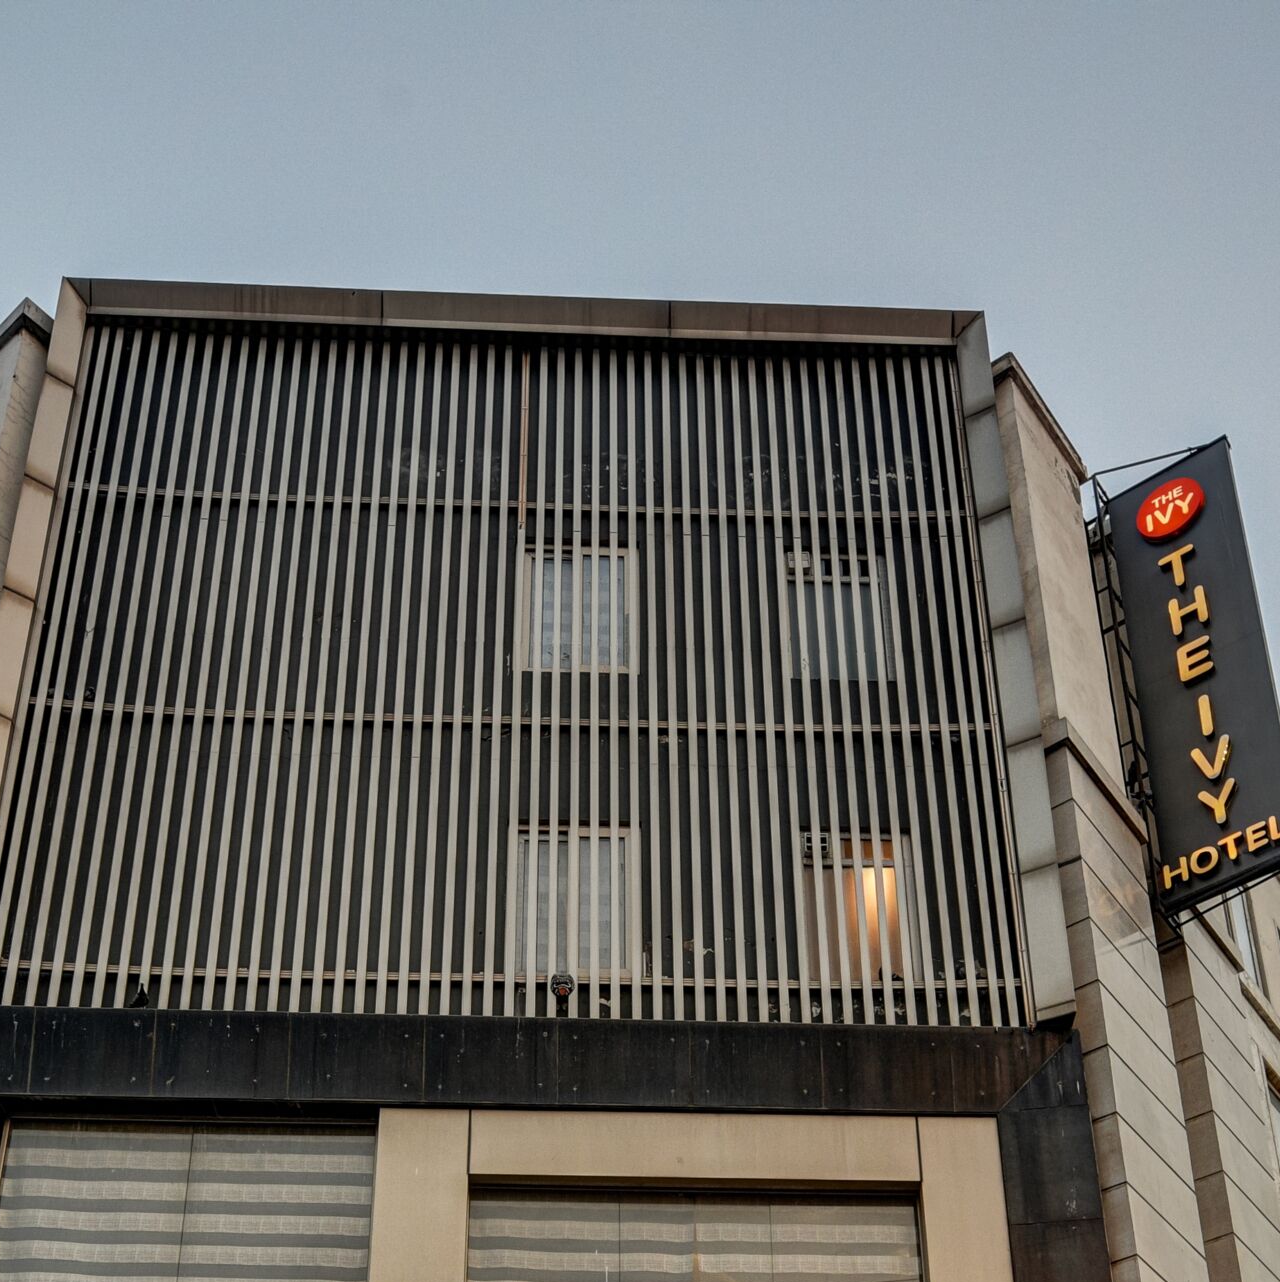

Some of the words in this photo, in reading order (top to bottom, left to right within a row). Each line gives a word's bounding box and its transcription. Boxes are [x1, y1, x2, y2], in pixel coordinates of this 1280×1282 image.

[1145, 491, 1194, 533] IVY
[1151, 485, 1183, 509] THE
[1157, 543, 1215, 684] THE
[1190, 694, 1237, 826] IVY
